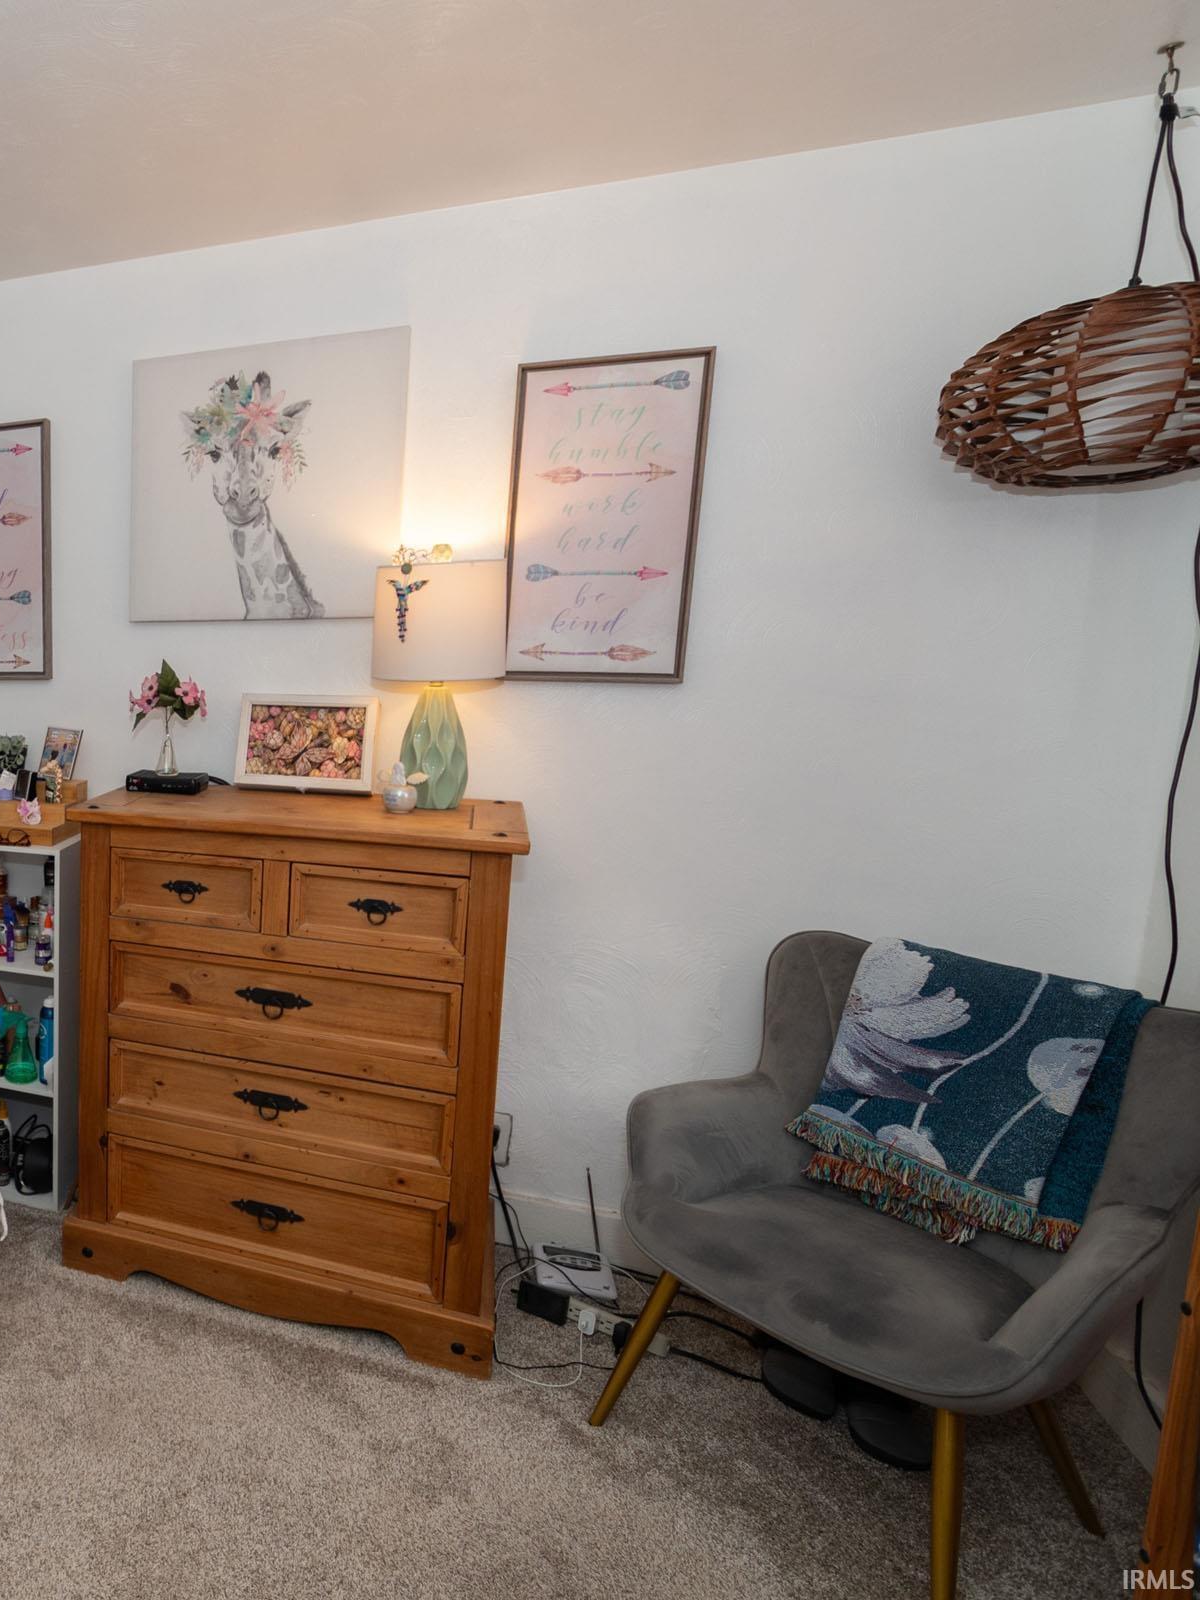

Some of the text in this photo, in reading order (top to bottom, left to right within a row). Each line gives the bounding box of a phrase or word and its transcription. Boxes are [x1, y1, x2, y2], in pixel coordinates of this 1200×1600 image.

[575, 403, 647, 430] stay
[548, 432, 663, 462] humble
[563, 489, 641, 516] work
[557, 525, 639, 552] hard
[575, 582, 606, 605] be
[551, 608, 626, 634] kind
